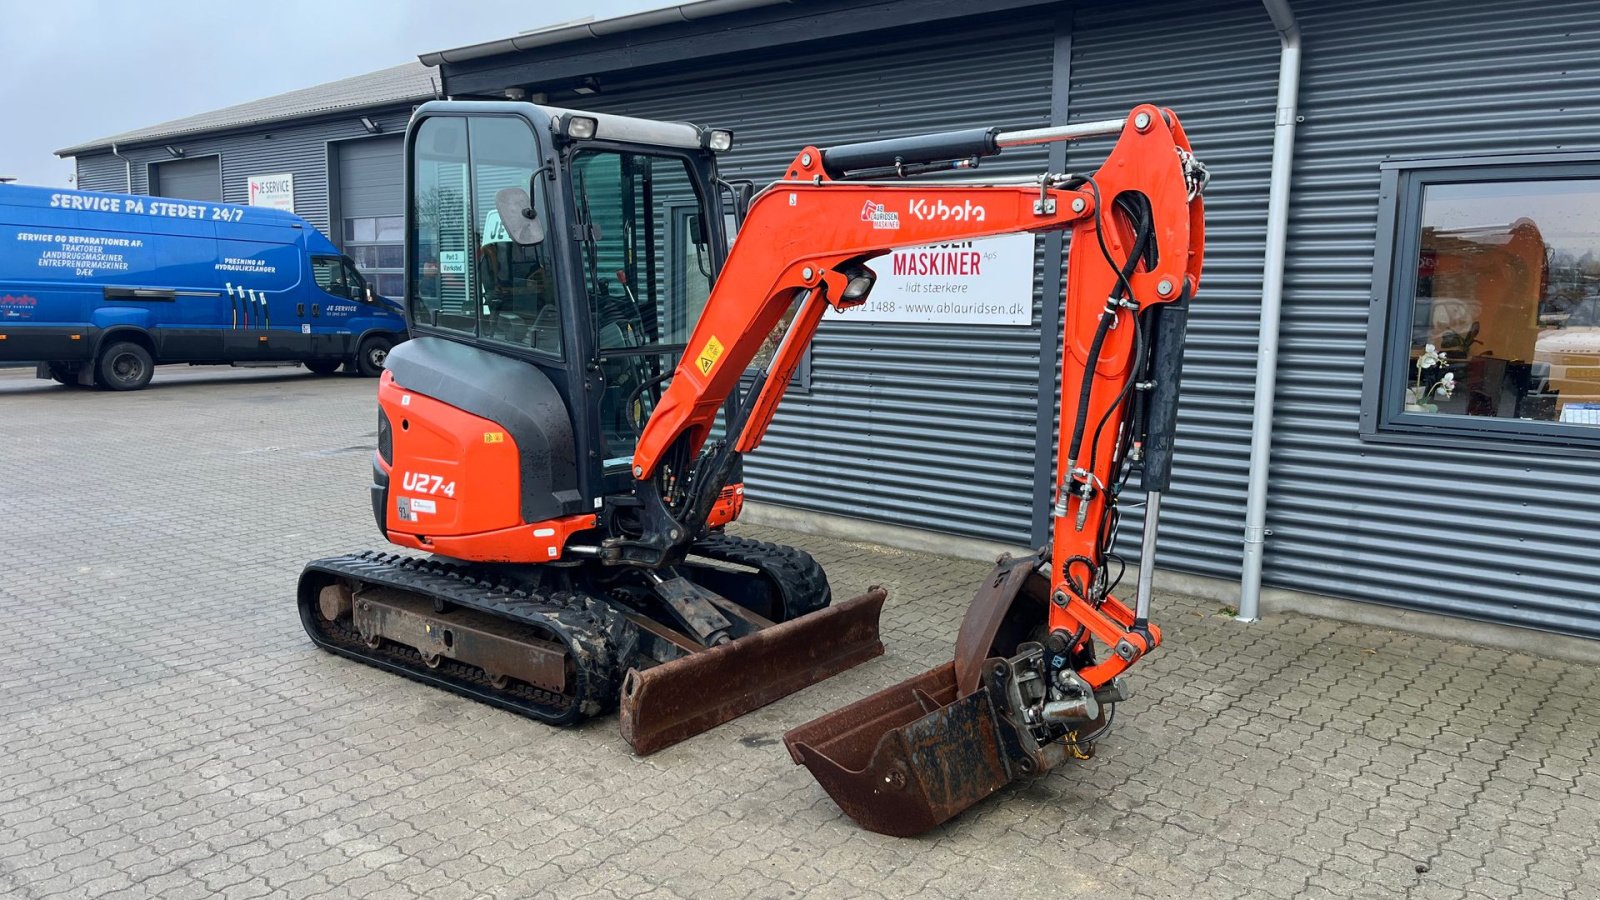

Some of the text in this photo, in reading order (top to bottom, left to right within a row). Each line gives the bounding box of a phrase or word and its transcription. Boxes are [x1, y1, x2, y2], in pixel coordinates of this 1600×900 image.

[258, 180, 289, 194] JE SERVICE
[50, 193, 243, 222] SERVICE PÅ STEDET 24/7
[909, 199, 985, 221] Kubota
[874, 220, 899, 228] MASKINER
[17, 233, 143, 248] SERVICE OG REPARATIONER AF:
[61, 244, 103, 253] TRAKTORER
[42, 251, 123, 262] LANDBRUGSMASKINER
[224, 258, 256, 266] PRESNING
[38, 259, 128, 270] ENTREPRENØRMASKINER
[214, 264, 276, 273] HYDRAULIKSLANGER
[893, 251, 997, 276] MASKINER ApS
[76, 268, 93, 276] DÆK
[905, 282, 921, 292] lidt
[923, 283, 968, 292] stærkere
[870, 301, 895, 312] 1488
[905, 302, 1024, 315] www.ablauridsen.dk
